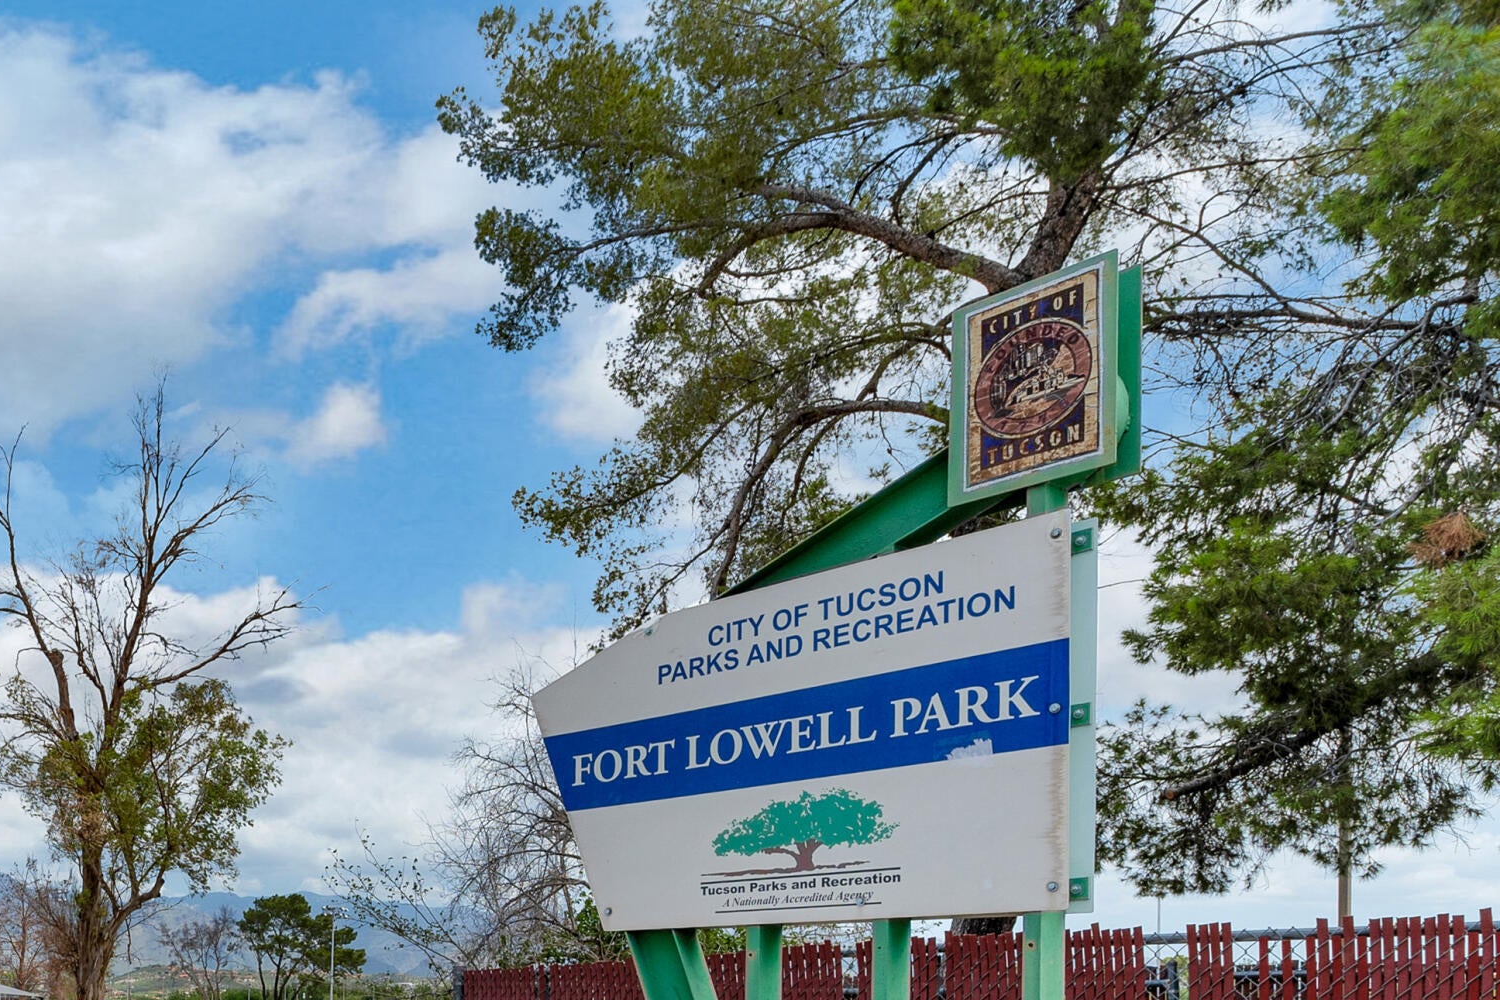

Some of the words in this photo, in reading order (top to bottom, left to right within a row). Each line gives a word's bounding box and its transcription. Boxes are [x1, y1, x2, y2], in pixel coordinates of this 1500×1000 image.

[989, 305, 1038, 334] CITY
[1052, 289, 1077, 311] OF
[987, 423, 1080, 465] TUCSON
[707, 614, 765, 647] CITY
[772, 603, 809, 631] OF
[817, 570, 944, 620] TUCSON
[658, 649, 739, 685] PARKS
[746, 634, 803, 666] AND
[813, 585, 1015, 651] RECREATION
[571, 738, 676, 787] FORT
[685, 705, 878, 770] LOWELL
[889, 675, 1041, 738] PARK
[700, 885, 746, 896] Tucson
[750, 881, 787, 893] Parks
[791, 878, 816, 890] and
[821, 873, 901, 888] Recreation
[722, 898, 730, 908] A
[732, 894, 781, 907] Nationally
[781, 891, 835, 904] Accredited
[835, 890, 875, 902] Agency
